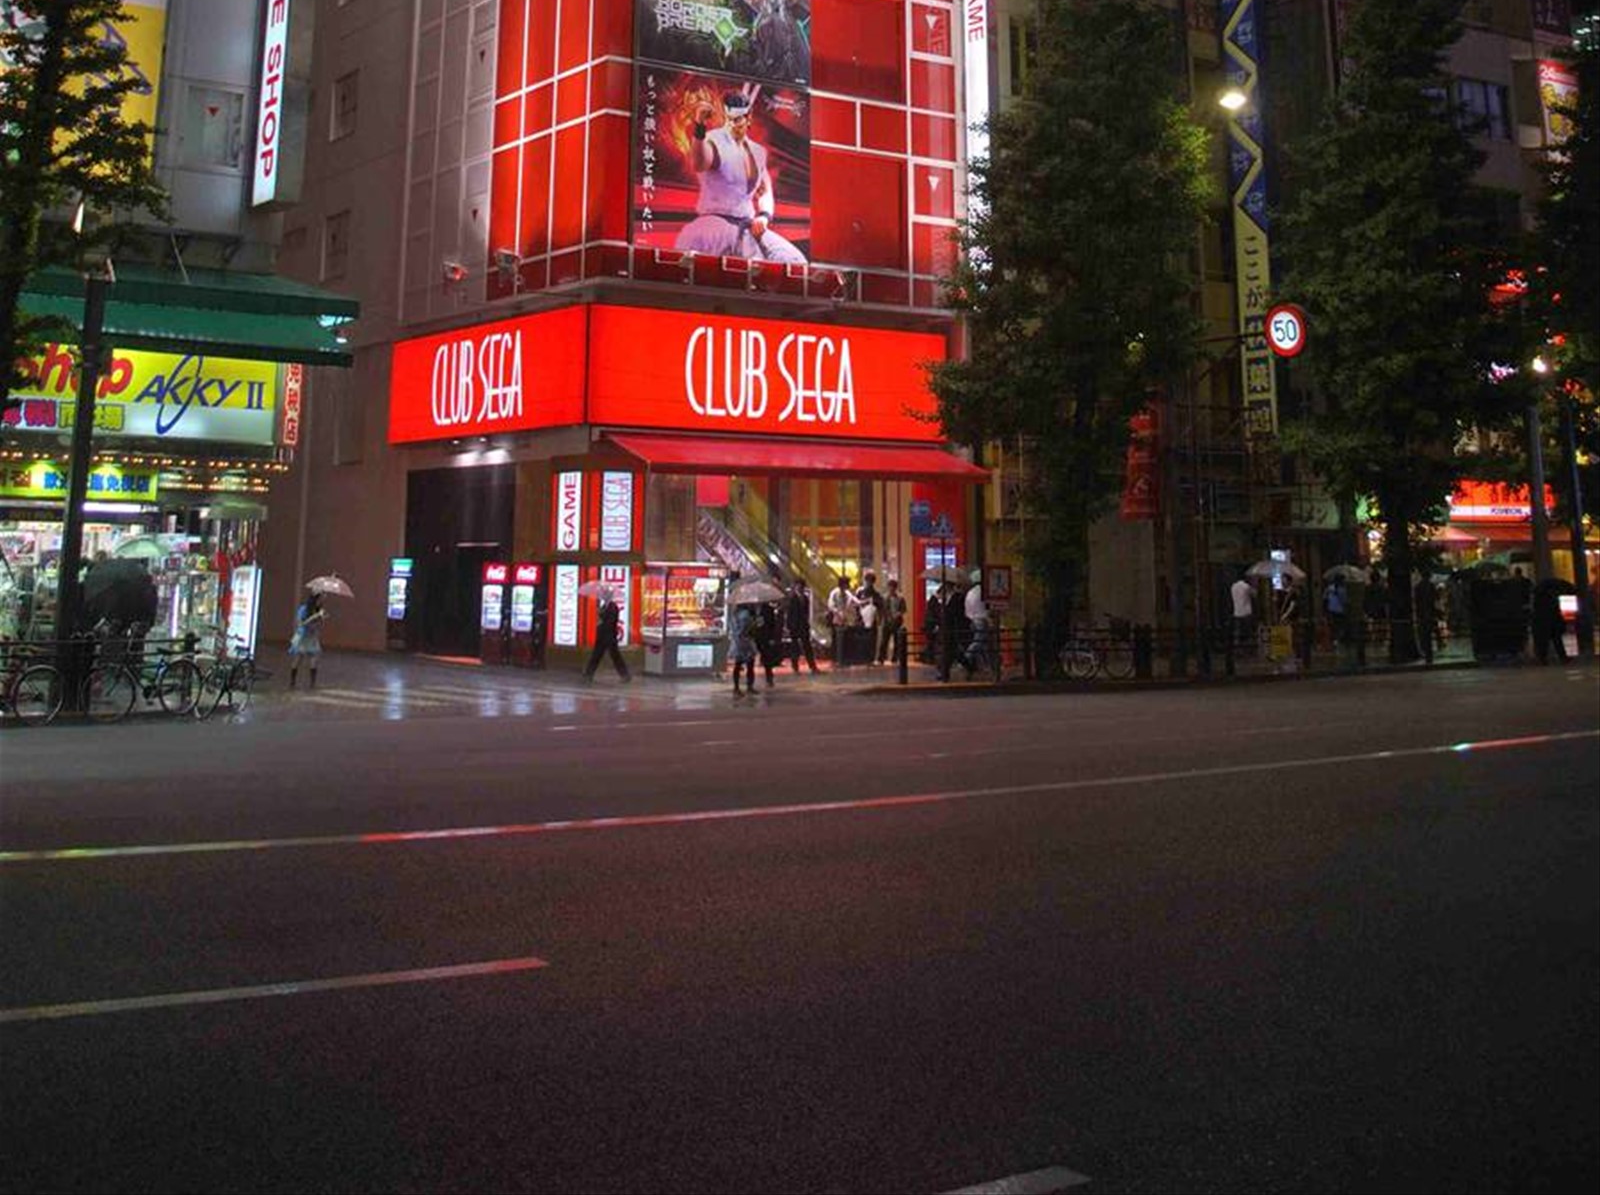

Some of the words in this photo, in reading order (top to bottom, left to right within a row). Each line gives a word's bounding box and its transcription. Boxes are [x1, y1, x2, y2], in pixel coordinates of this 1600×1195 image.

[260, 43, 281, 178] SHOP
[1273, 319, 1297, 343] 50
[431, 340, 474, 426] CLUB
[477, 329, 522, 422] SEGA
[685, 326, 768, 419] CLUB
[777, 333, 857, 424] SEGA
[563, 474, 576, 548] GAME
[605, 477, 629, 511] SEGA
